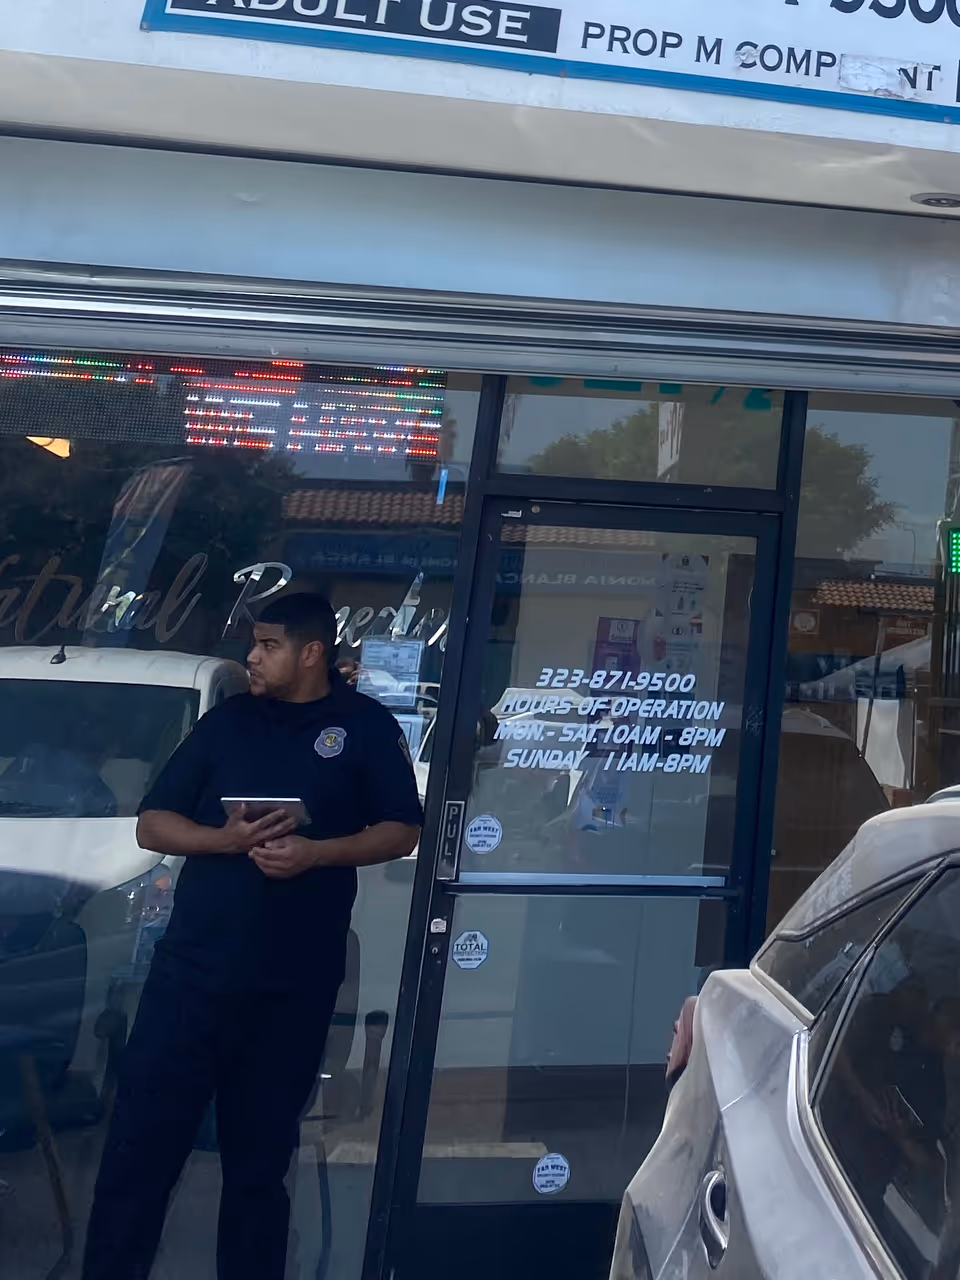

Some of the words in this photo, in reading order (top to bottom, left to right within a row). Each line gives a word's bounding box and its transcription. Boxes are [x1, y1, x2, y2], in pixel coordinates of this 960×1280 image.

[581, 22, 684, 58] PROP
[695, 35, 723, 65] M
[535, 668, 696, 693] 323-871-9500
[500, 694, 572, 715] HOURS
[578, 695, 610, 716] OF
[612, 698, 725, 720] OPERATION
[603, 723, 662, 745] 10AM
[678, 727, 727, 748] 8PM
[503, 748, 591, 770] SUNDAY
[455, 942, 487, 951] TOTAL
